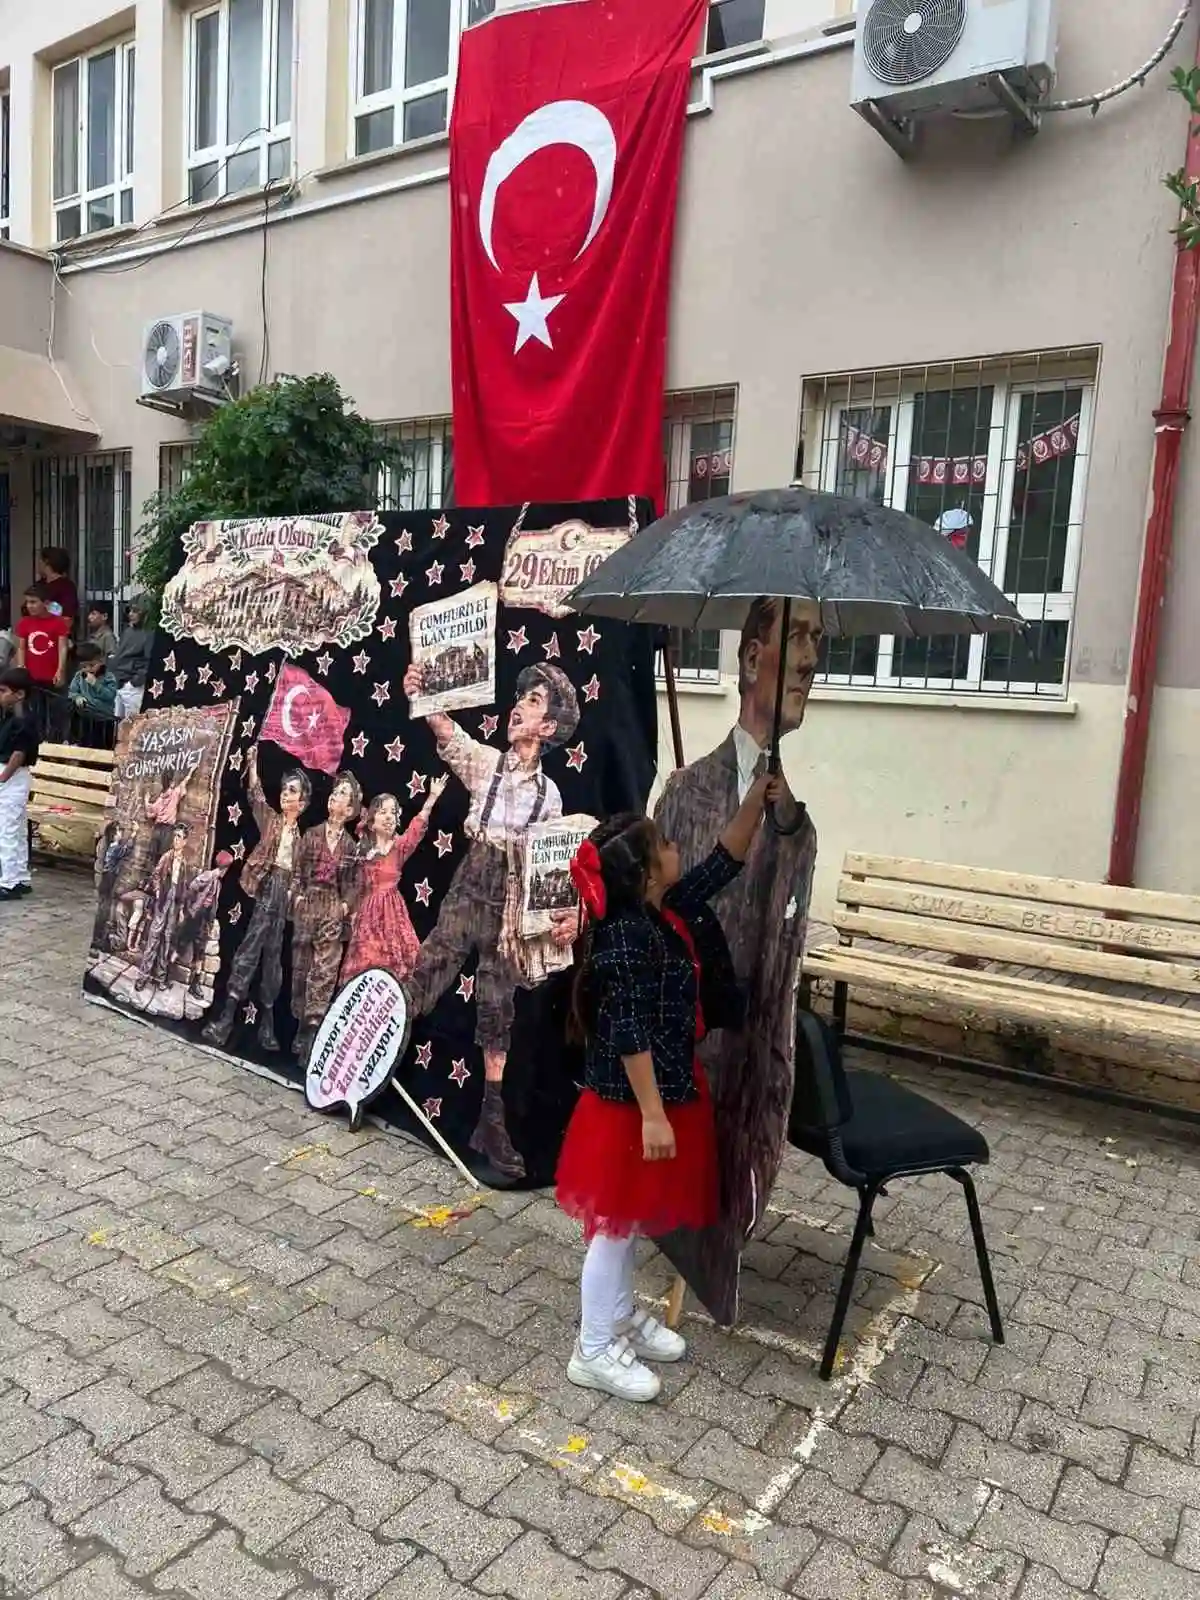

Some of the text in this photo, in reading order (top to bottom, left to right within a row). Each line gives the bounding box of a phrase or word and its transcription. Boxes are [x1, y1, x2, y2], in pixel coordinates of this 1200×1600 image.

[239, 526, 276, 550] Kutlu
[279, 520, 315, 549] Olsun
[504, 553, 538, 589] 29
[538, 558, 579, 586] Ekim
[420, 596, 490, 631] CUMHURİYET
[449, 612, 488, 639] EDİLDİ
[140, 726, 196, 753] YAŞASIN
[125, 746, 206, 779] CUMHURİYET
[531, 831, 587, 850] CUMHURİYET
[355, 988, 400, 1061] edildiğini
[310, 1021, 342, 1080] Yazıyor
[358, 1015, 401, 1091] yazıyor!
